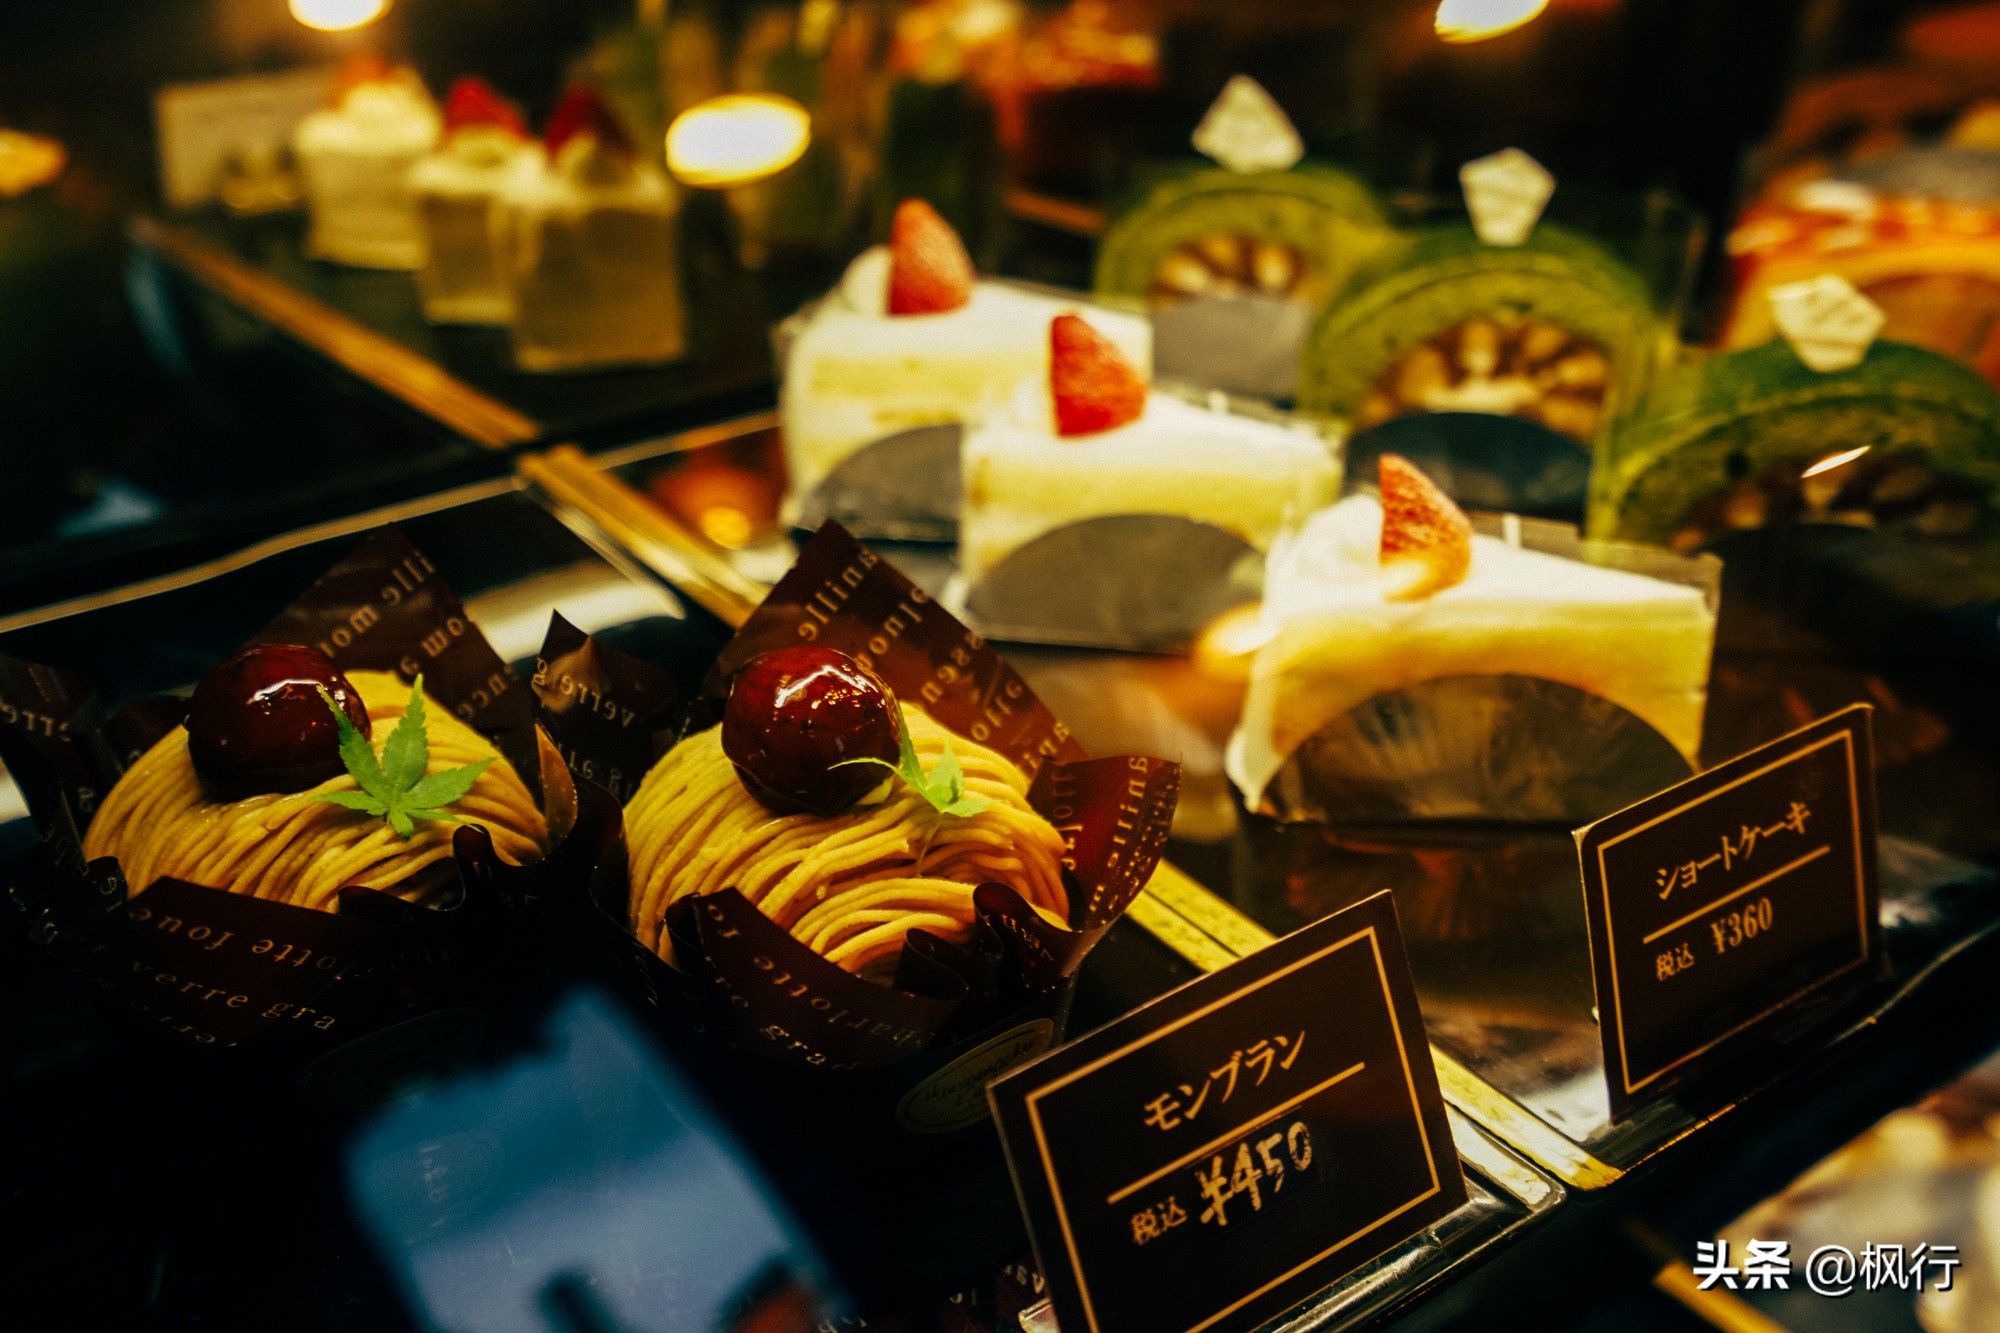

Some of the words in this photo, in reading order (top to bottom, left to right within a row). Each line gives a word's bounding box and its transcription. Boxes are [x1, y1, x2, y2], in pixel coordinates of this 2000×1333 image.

[1656, 801, 1814, 900] ショートケーキ
[1656, 943, 1695, 983] 税込
[1710, 896, 1774, 956] ¥360
[130, 960, 250, 1009] verre
[261, 1001, 338, 1032] gra
[1143, 1029, 1307, 1132] モンブラン
[1129, 1195, 1188, 1246] 税込
[1194, 1120, 1313, 1227] ¥450
